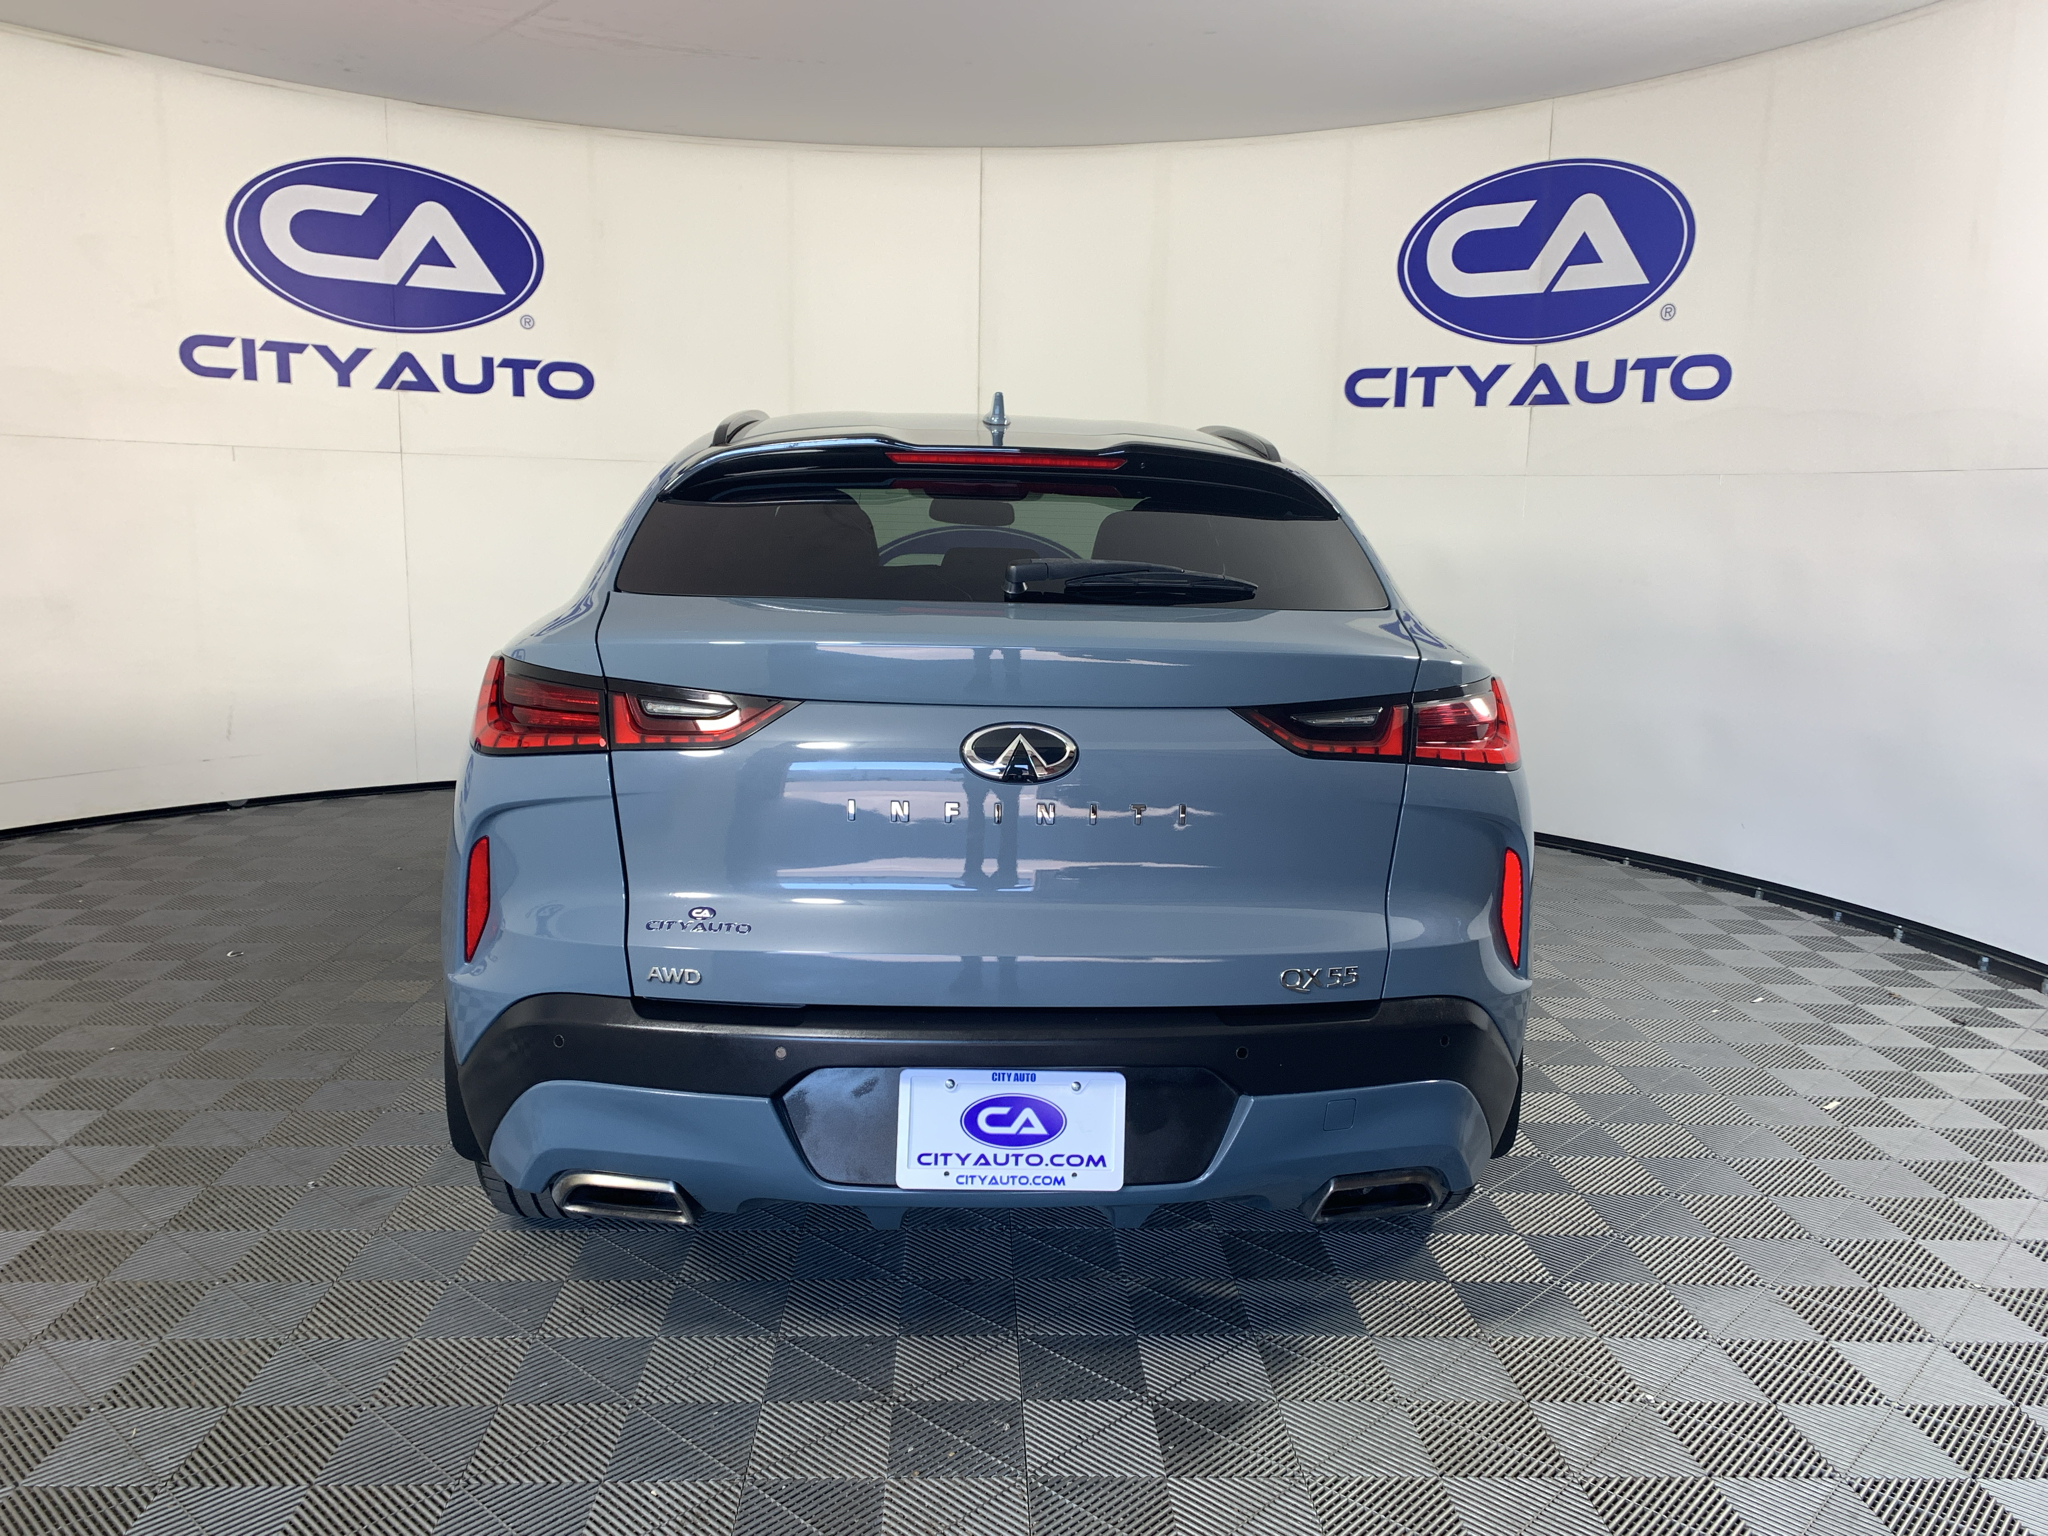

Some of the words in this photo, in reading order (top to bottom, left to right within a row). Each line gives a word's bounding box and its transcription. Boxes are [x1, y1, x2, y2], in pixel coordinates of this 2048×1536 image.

[259, 184, 506, 295] CA
[1426, 192, 1650, 298] CA
[847, 798, 1187, 826] INFINITI
[646, 966, 702, 985] AWD
[991, 1072, 1012, 1083] CITY
[1013, 1073, 1037, 1083] AUTO
[977, 1106, 1050, 1136] CA
[916, 1152, 1107, 1168] CITYAUTO.COM
[955, 1174, 1066, 1187] CITYAUTO.COM
